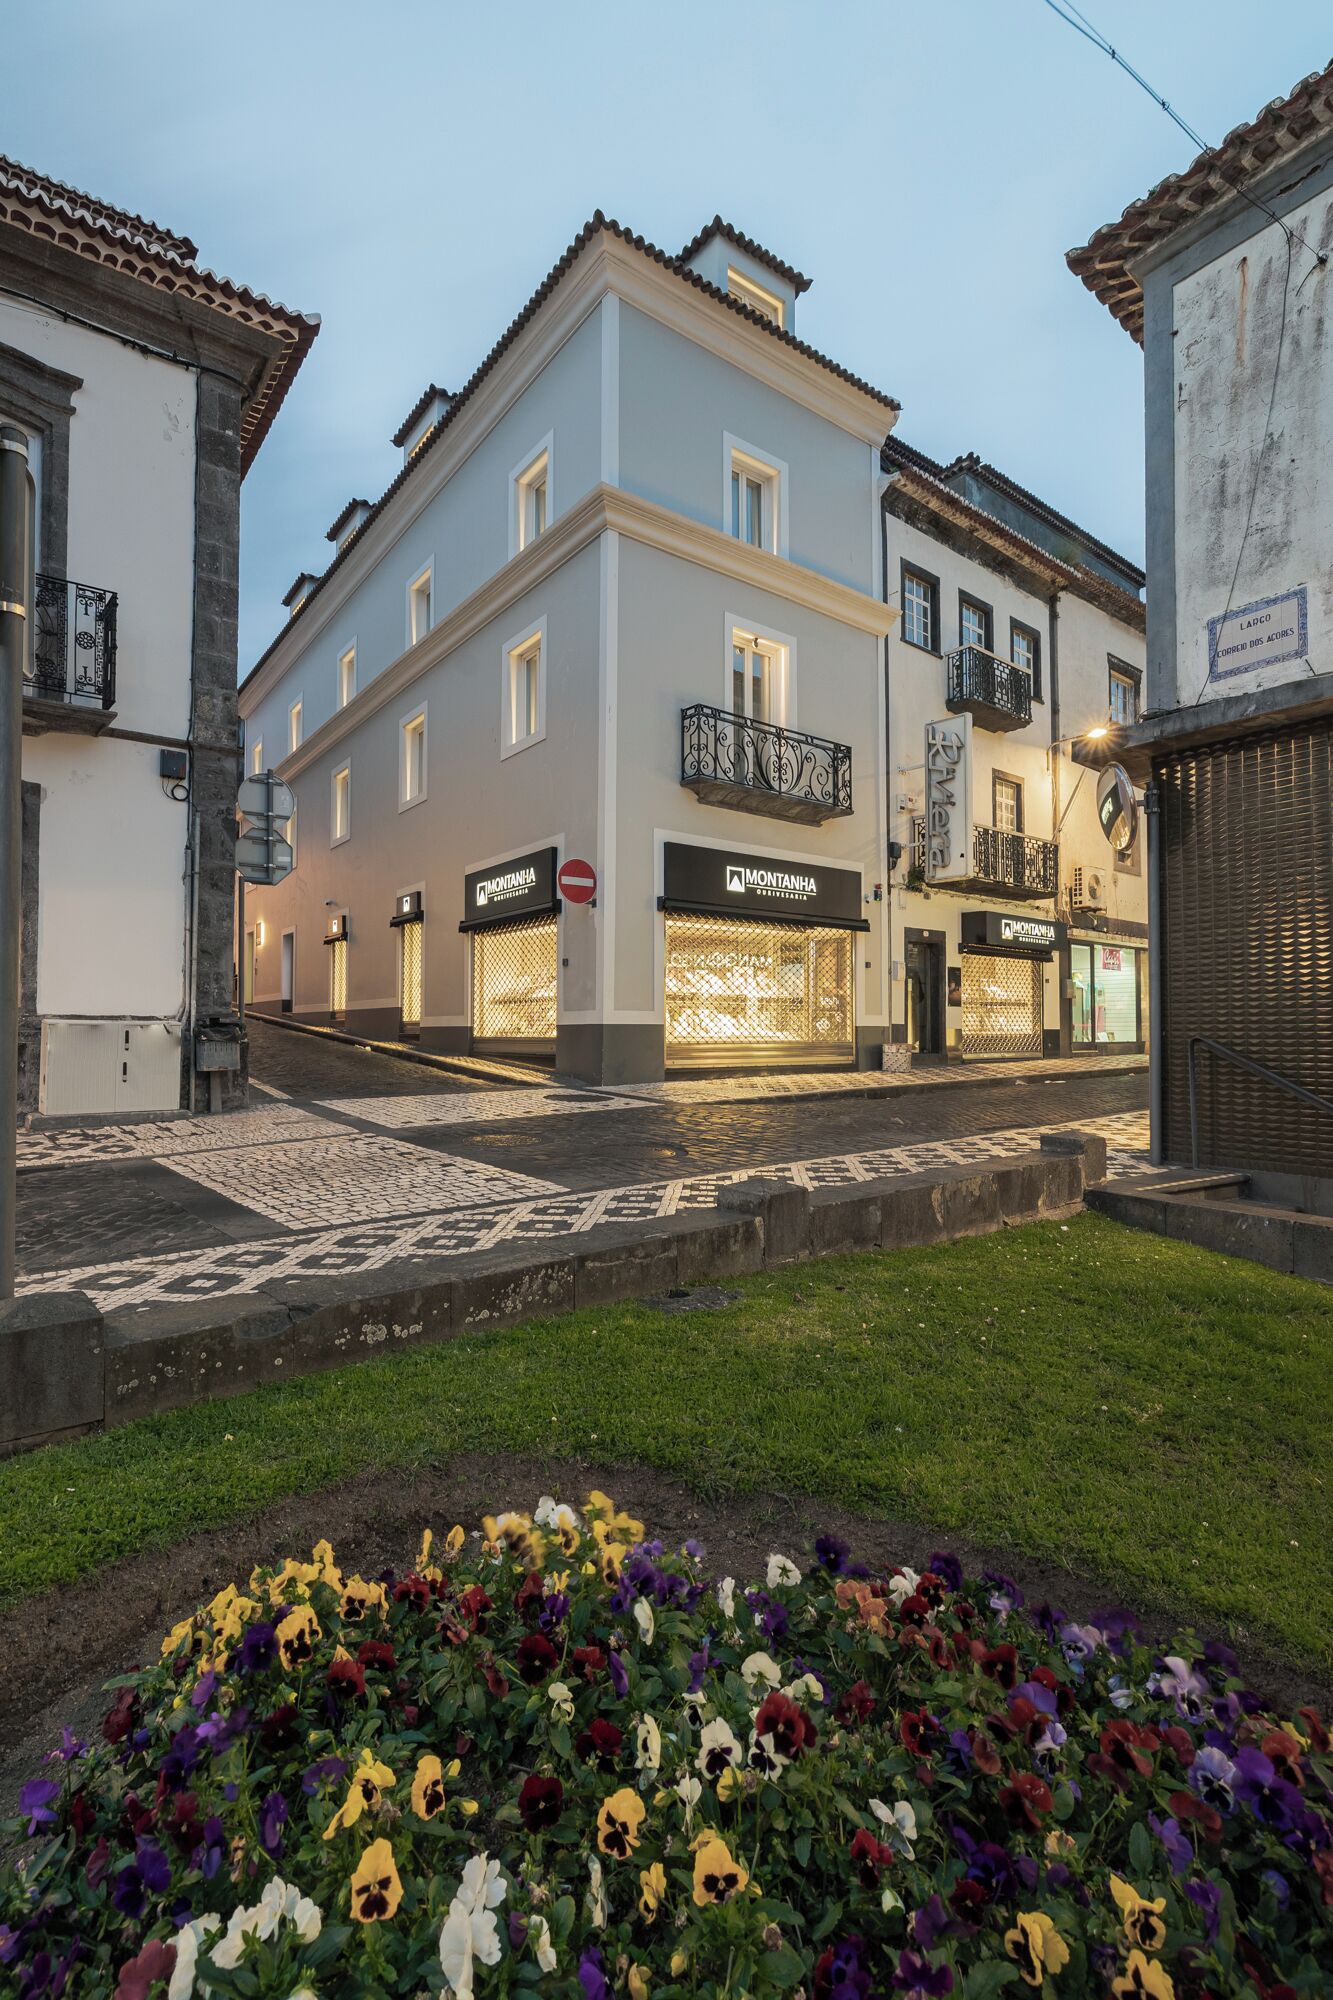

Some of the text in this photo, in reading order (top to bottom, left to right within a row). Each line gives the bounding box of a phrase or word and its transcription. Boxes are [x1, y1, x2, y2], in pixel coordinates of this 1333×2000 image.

[1217, 642, 1247, 658] CORREIO
[1249, 638, 1264, 649] DOS
[488, 867, 536, 894] MONTANHA
[746, 868, 817, 893] MONTANHA
[756, 889, 808, 901] OURIVESARIA
[1013, 920, 1056, 938] MONTANHA
